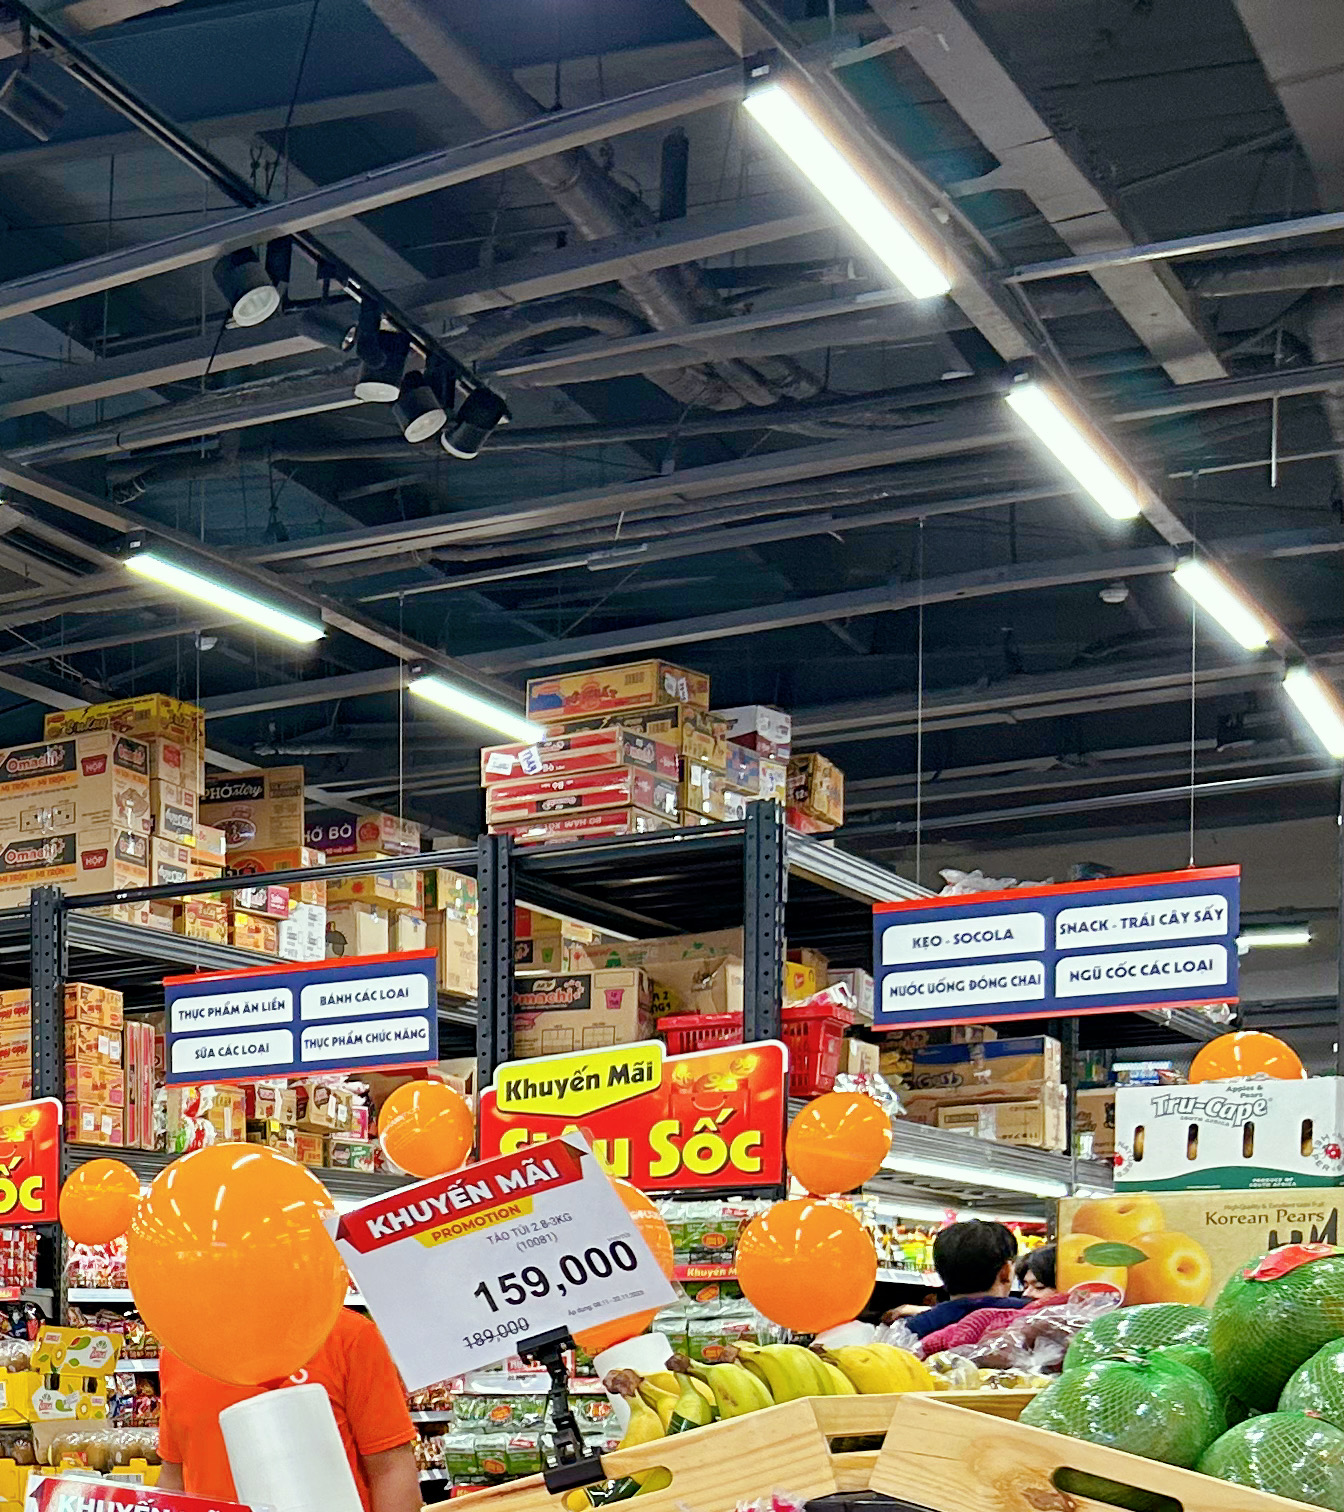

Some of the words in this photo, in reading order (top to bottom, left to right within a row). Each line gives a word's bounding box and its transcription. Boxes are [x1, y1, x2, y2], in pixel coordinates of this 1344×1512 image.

[1059, 918, 1109, 936] SNACK
[1120, 910, 1155, 930] TRÁI
[1158, 907, 1190, 926] CÂY
[1194, 902, 1224, 923] SẤY
[912, 934, 942, 950] KẸO
[953, 927, 1015, 946] SOCOLA
[889, 978, 925, 998] NƯỚC
[927, 975, 966, 995] UỐNG
[968, 971, 1008, 992] ĐÓNG
[1011, 972, 1042, 988] CHAI
[1070, 965, 1102, 983] NGŨ
[1105, 958, 1137, 978] CỐC
[1140, 957, 1172, 976] CÁC
[1174, 958, 1214, 975] LOẠI
[179, 1008, 205, 1022] THỰC
[208, 1000, 240, 1017] PHẨM
[243, 1002, 258, 1014] ĂN
[320, 993, 352, 1006] BÁNH
[354, 989, 378, 1002] CÁC
[194, 1046, 216, 1060] SỮA
[218, 1043, 240, 1057] CÁC
[242, 1043, 269, 1055] LOẠI
[304, 1035, 330, 1049] THỰC
[332, 1029, 363, 1046] PHẨM
[365, 1027, 392, 1043] CHỨC
[394, 1028, 426, 1041] NĂNG
[505, 1065, 600, 1103] Khuyến
[607, 1060, 653, 1088] Mãi
[1150, 1094, 1268, 1128] Tru-Cape
[649, 1108, 762, 1178] Sốc
[367, 1171, 494, 1240] KHUYẾN
[499, 1157, 560, 1196] MÃI
[432, 1202, 522, 1243] PROMOTION
[487, 1228, 510, 1246] TÁO
[512, 1223, 530, 1239] TÚI
[530, 1212, 573, 1234] 2.8-3KG
[1205, 1211, 1269, 1225] Korean
[1276, 1209, 1325, 1223] Pears
[516, 1231, 559, 1252] (10081)
[473, 1239, 639, 1314] 159,000
[463, 1317, 530, 1349] 189,000
